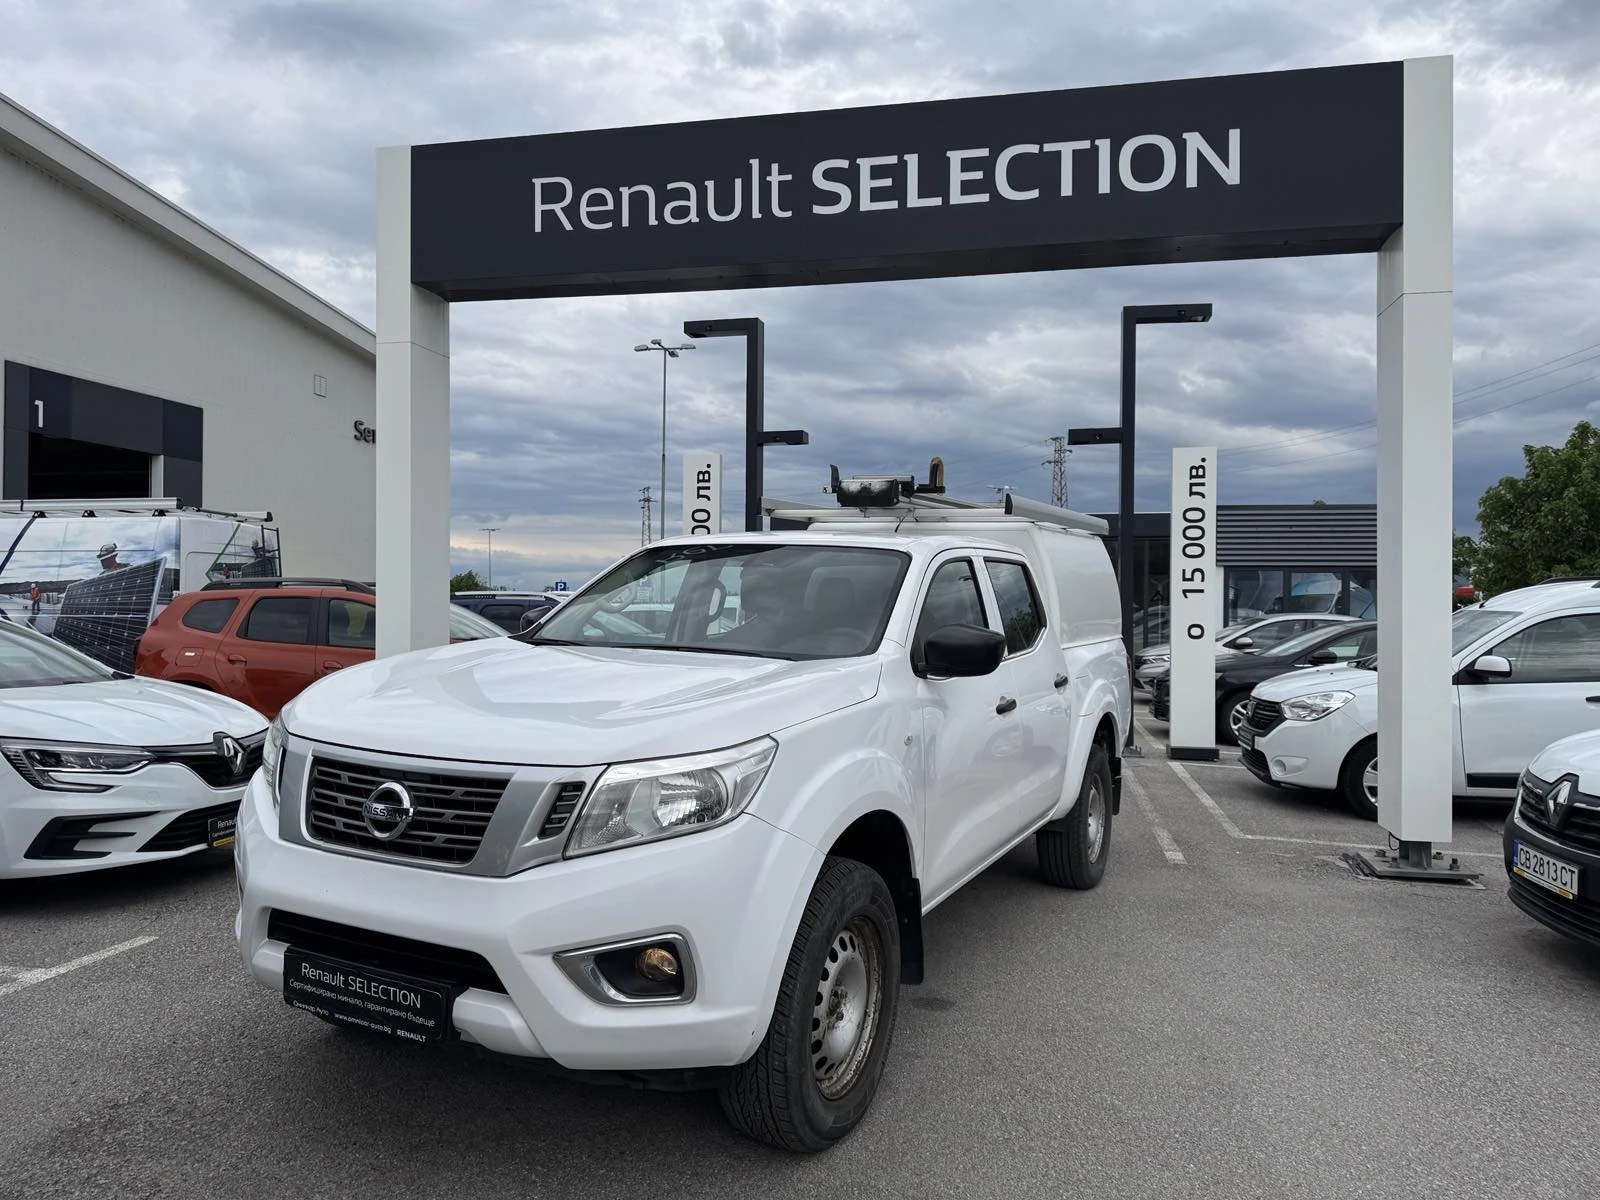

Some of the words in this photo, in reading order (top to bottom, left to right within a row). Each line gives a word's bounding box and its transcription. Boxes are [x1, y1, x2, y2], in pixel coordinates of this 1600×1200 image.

[532, 158, 793, 233] Renault
[811, 128, 1241, 215] SELECTION
[34, 399, 44, 428] 1
[353, 419, 376, 444] Ser
[696, 463, 711, 501] лв.
[1189, 457, 1207, 499] лв.
[691, 508, 711, 535] 00
[1182, 507, 1206, 559] 000
[1182, 567, 1206, 599] 15
[363, 802, 408, 820] NISSAN
[1519, 848, 1531, 869] CB
[1532, 854, 1558, 882] 2813
[1560, 866, 1576, 890] CT
[289, 979, 336, 1000] Сертифицирано
[337, 994, 364, 1008] минало,
[364, 1002, 407, 1019] гарантирано
[407, 1012, 435, 1027] бъдеще
[301, 963, 345, 988] Renault
[348, 976, 421, 1009] SELECTION
[397, 1029, 427, 1043] RENAULT
